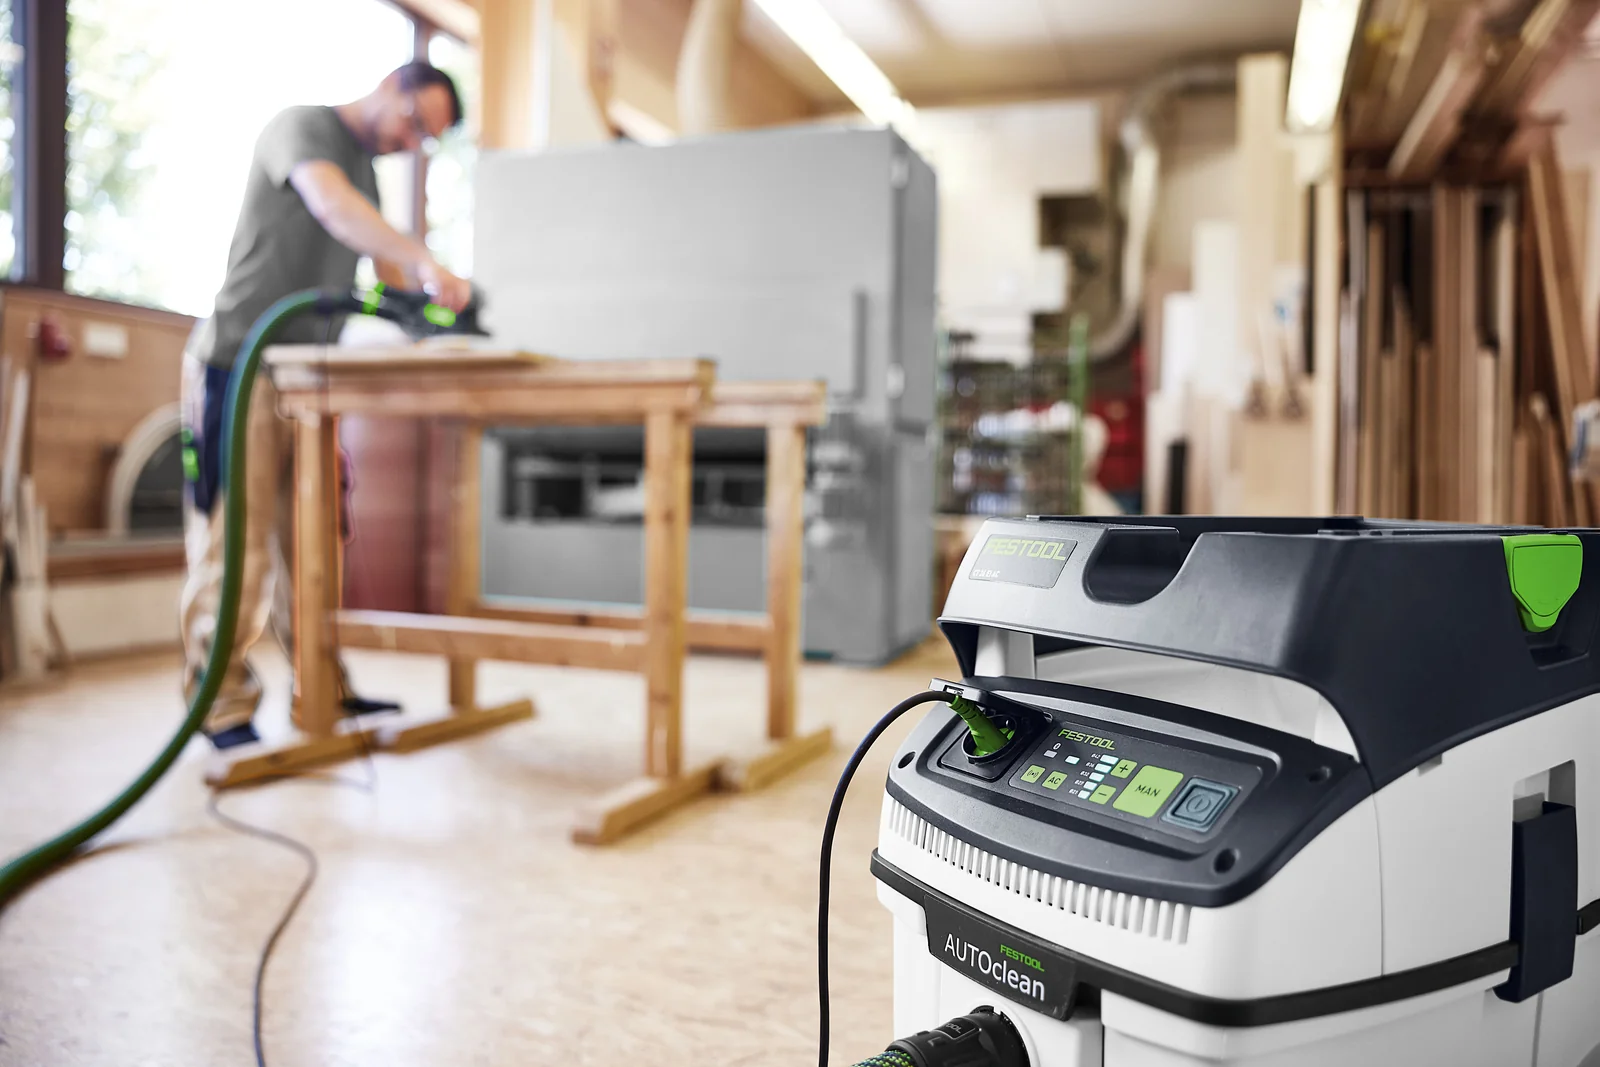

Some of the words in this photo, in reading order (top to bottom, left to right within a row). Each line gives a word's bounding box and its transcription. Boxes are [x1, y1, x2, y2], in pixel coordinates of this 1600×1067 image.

[982, 538, 1066, 560] FESTOOL
[1058, 729, 1116, 751] FESTOOL
[1048, 776, 1061, 785] AC
[1135, 784, 1161, 797] MAN
[944, 933, 1045, 1002] AUTOclean
[1000, 944, 1045, 972] FESTOOL
